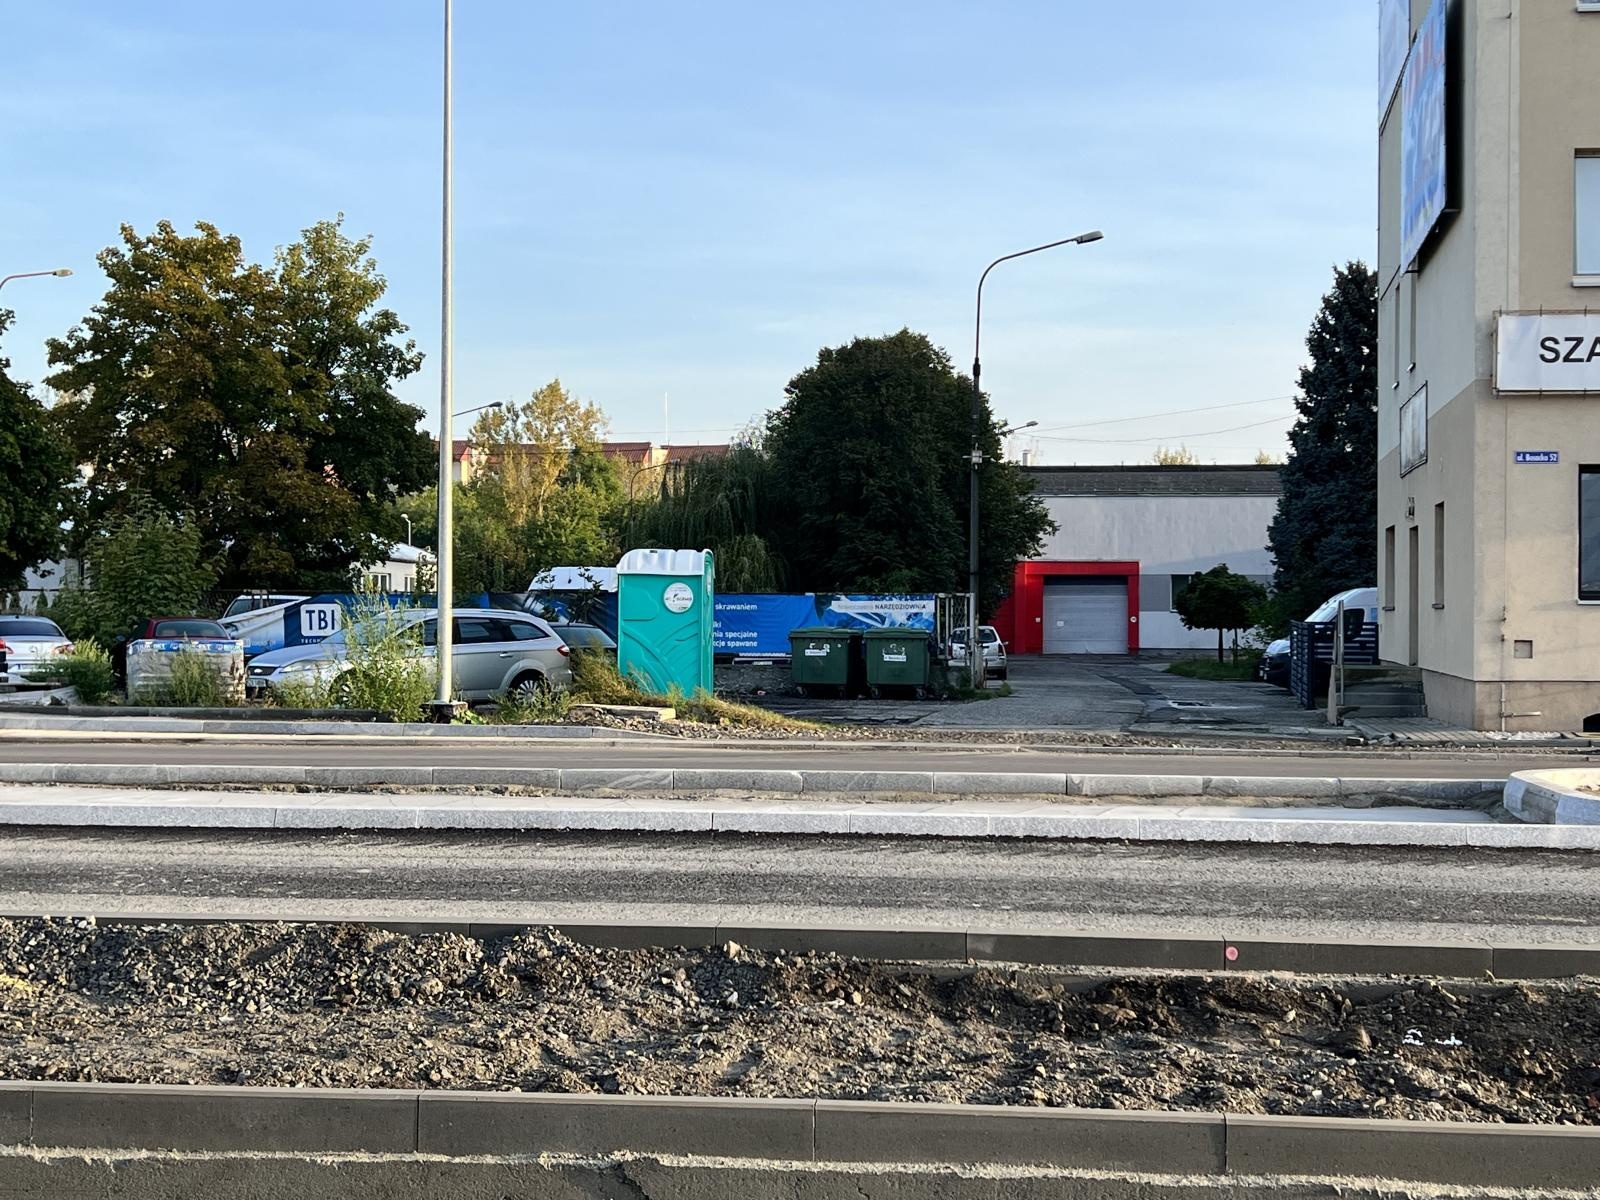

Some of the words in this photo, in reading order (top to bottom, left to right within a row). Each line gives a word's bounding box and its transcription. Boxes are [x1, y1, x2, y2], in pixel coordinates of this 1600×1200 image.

[1539, 336, 1600, 363] SZA
[1549, 453, 1557, 461] 52
[306, 609, 335, 630] TBI
[725, 631, 758, 639] specjalne
